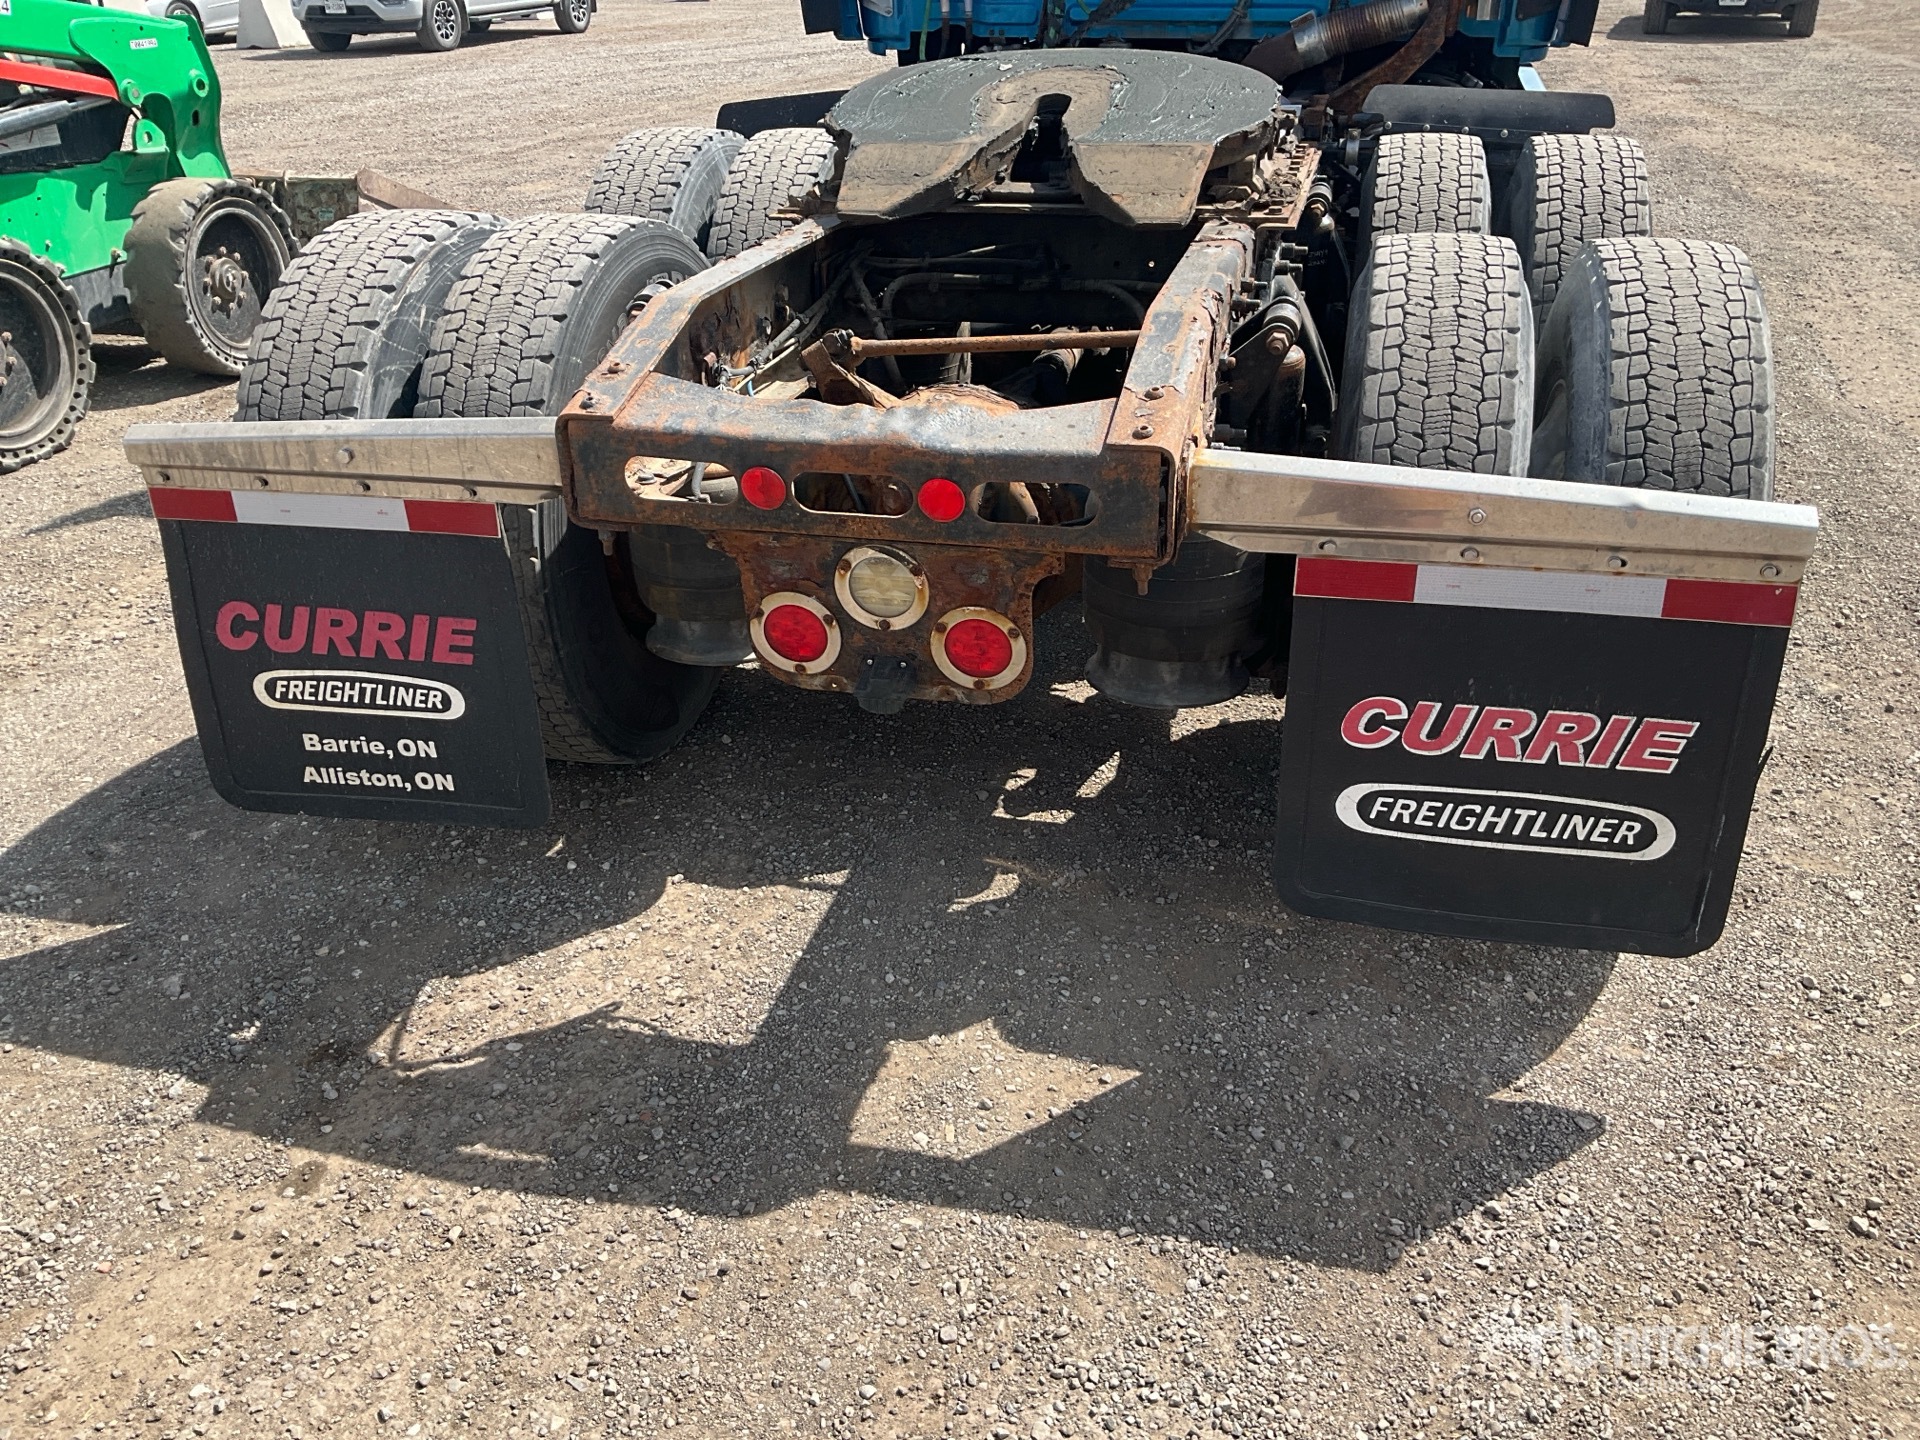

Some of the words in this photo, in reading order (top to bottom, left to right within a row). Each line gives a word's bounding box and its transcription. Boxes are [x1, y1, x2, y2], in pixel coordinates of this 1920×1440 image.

[214, 600, 478, 666] CURRIE
[274, 679, 444, 710] FREIGHTLINER
[1340, 695, 1700, 774] CURRIE
[1368, 796, 1643, 846] FREIGHTLINER
